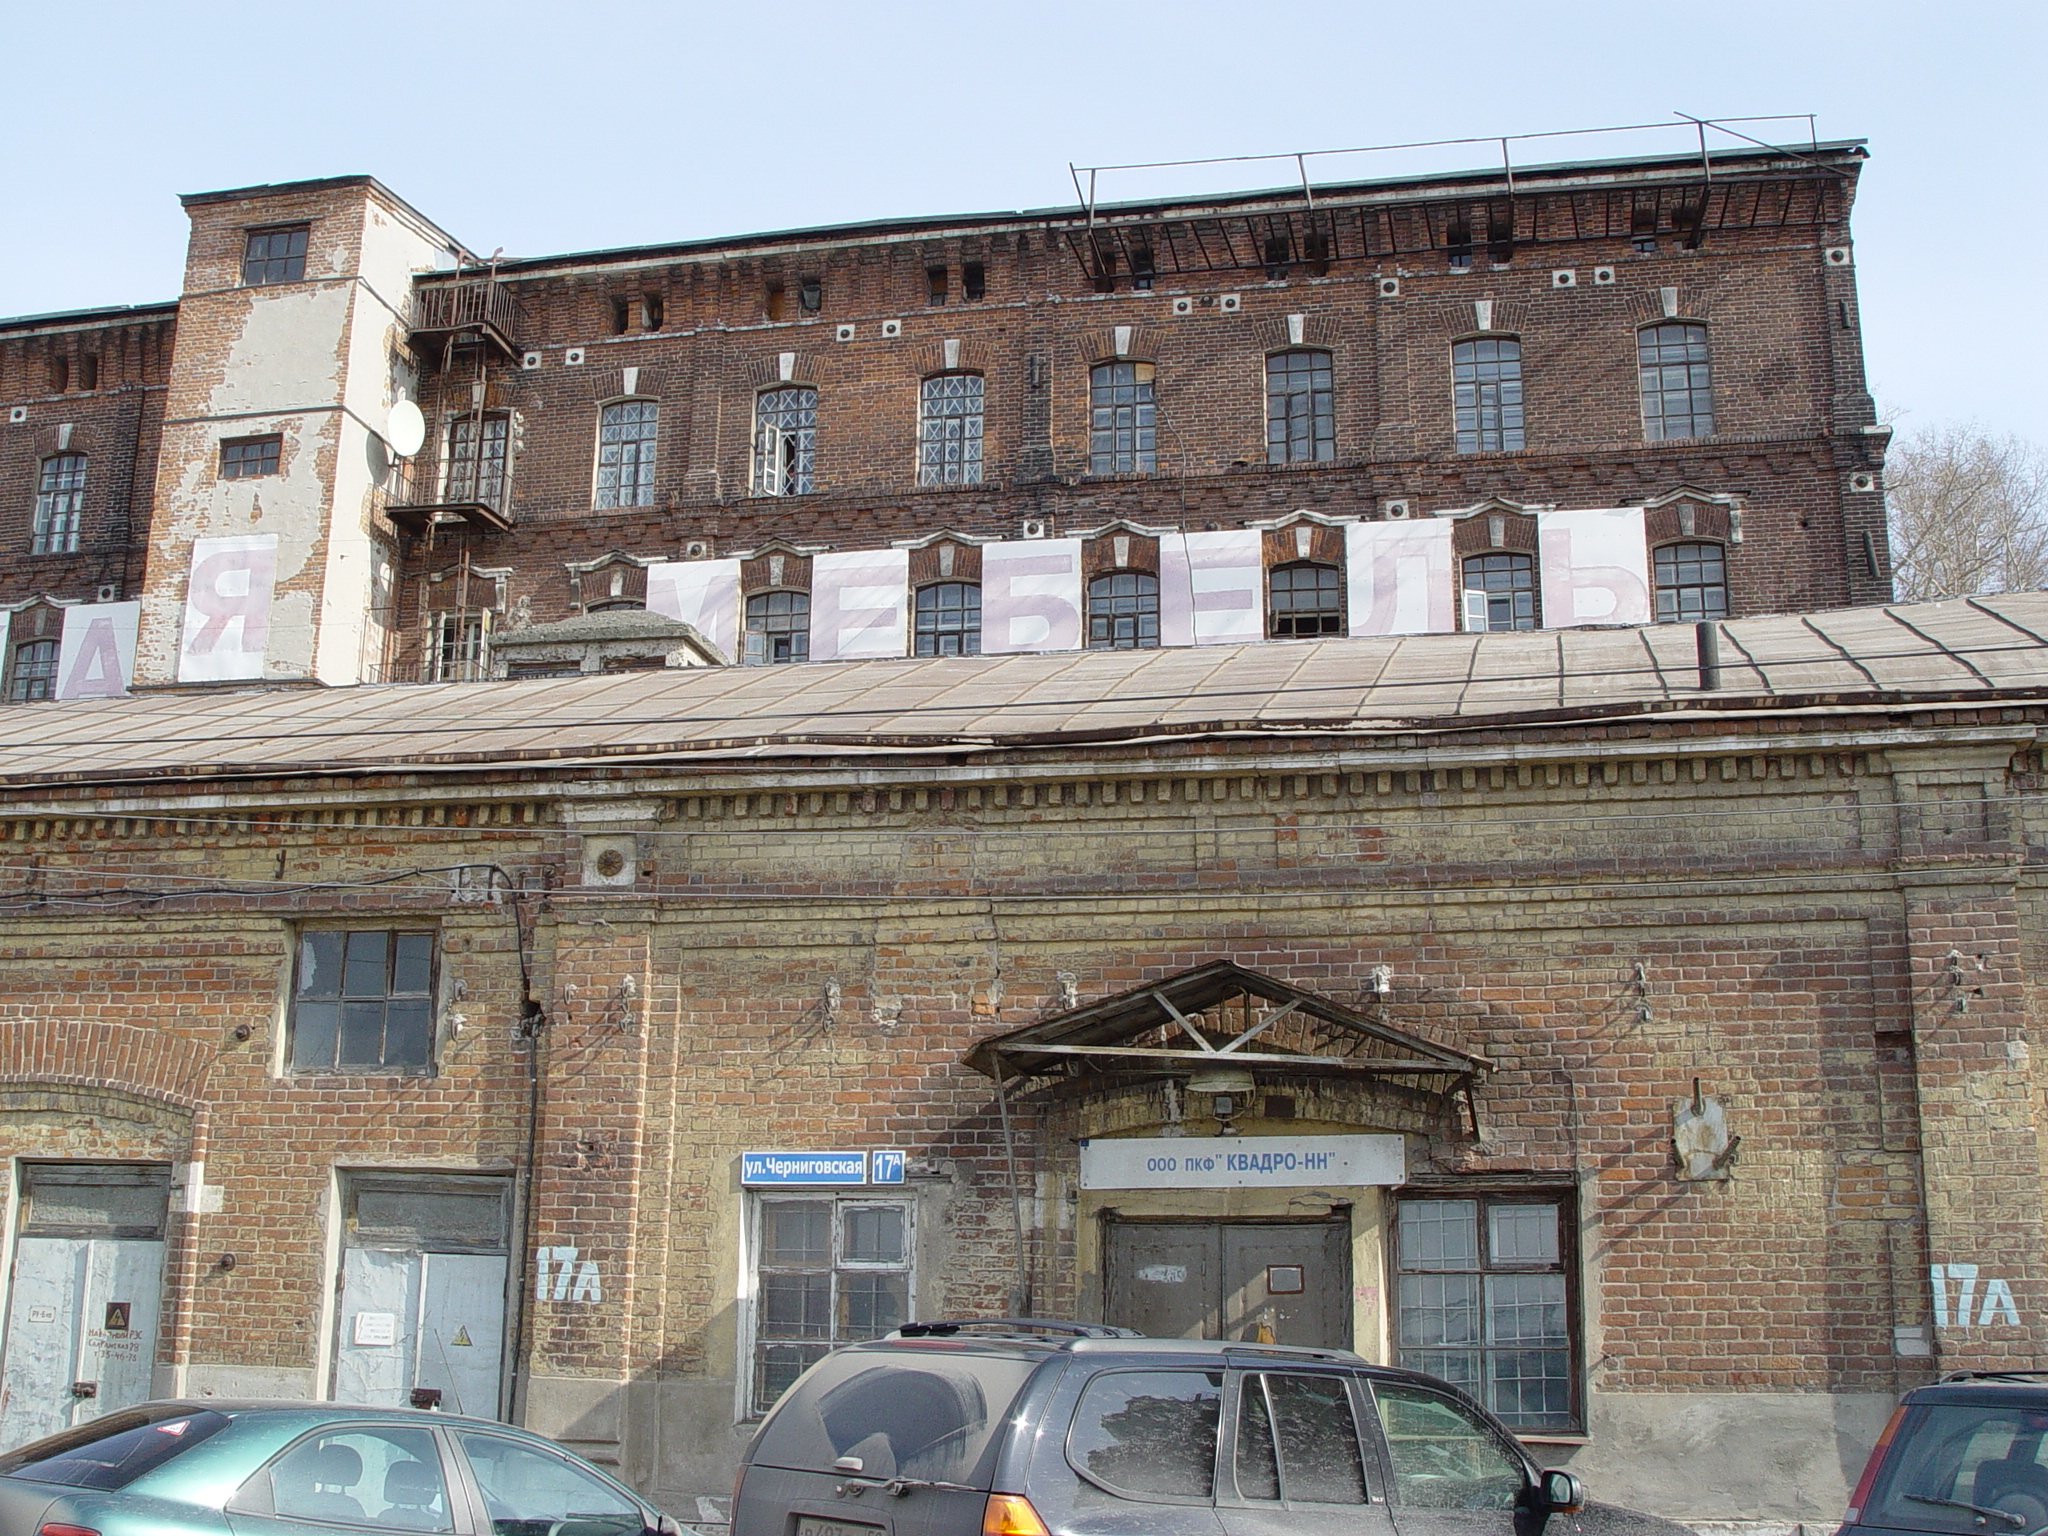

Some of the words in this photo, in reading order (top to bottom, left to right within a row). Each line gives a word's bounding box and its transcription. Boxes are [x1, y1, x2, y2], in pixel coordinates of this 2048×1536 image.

[745, 1156, 863, 1178] ул.Черниговская
[875, 1154, 901, 1180] 17А
[1147, 1157, 1177, 1172] ООО
[536, 1246, 601, 1304] 17А
[1930, 1263, 2021, 1327] 17А
